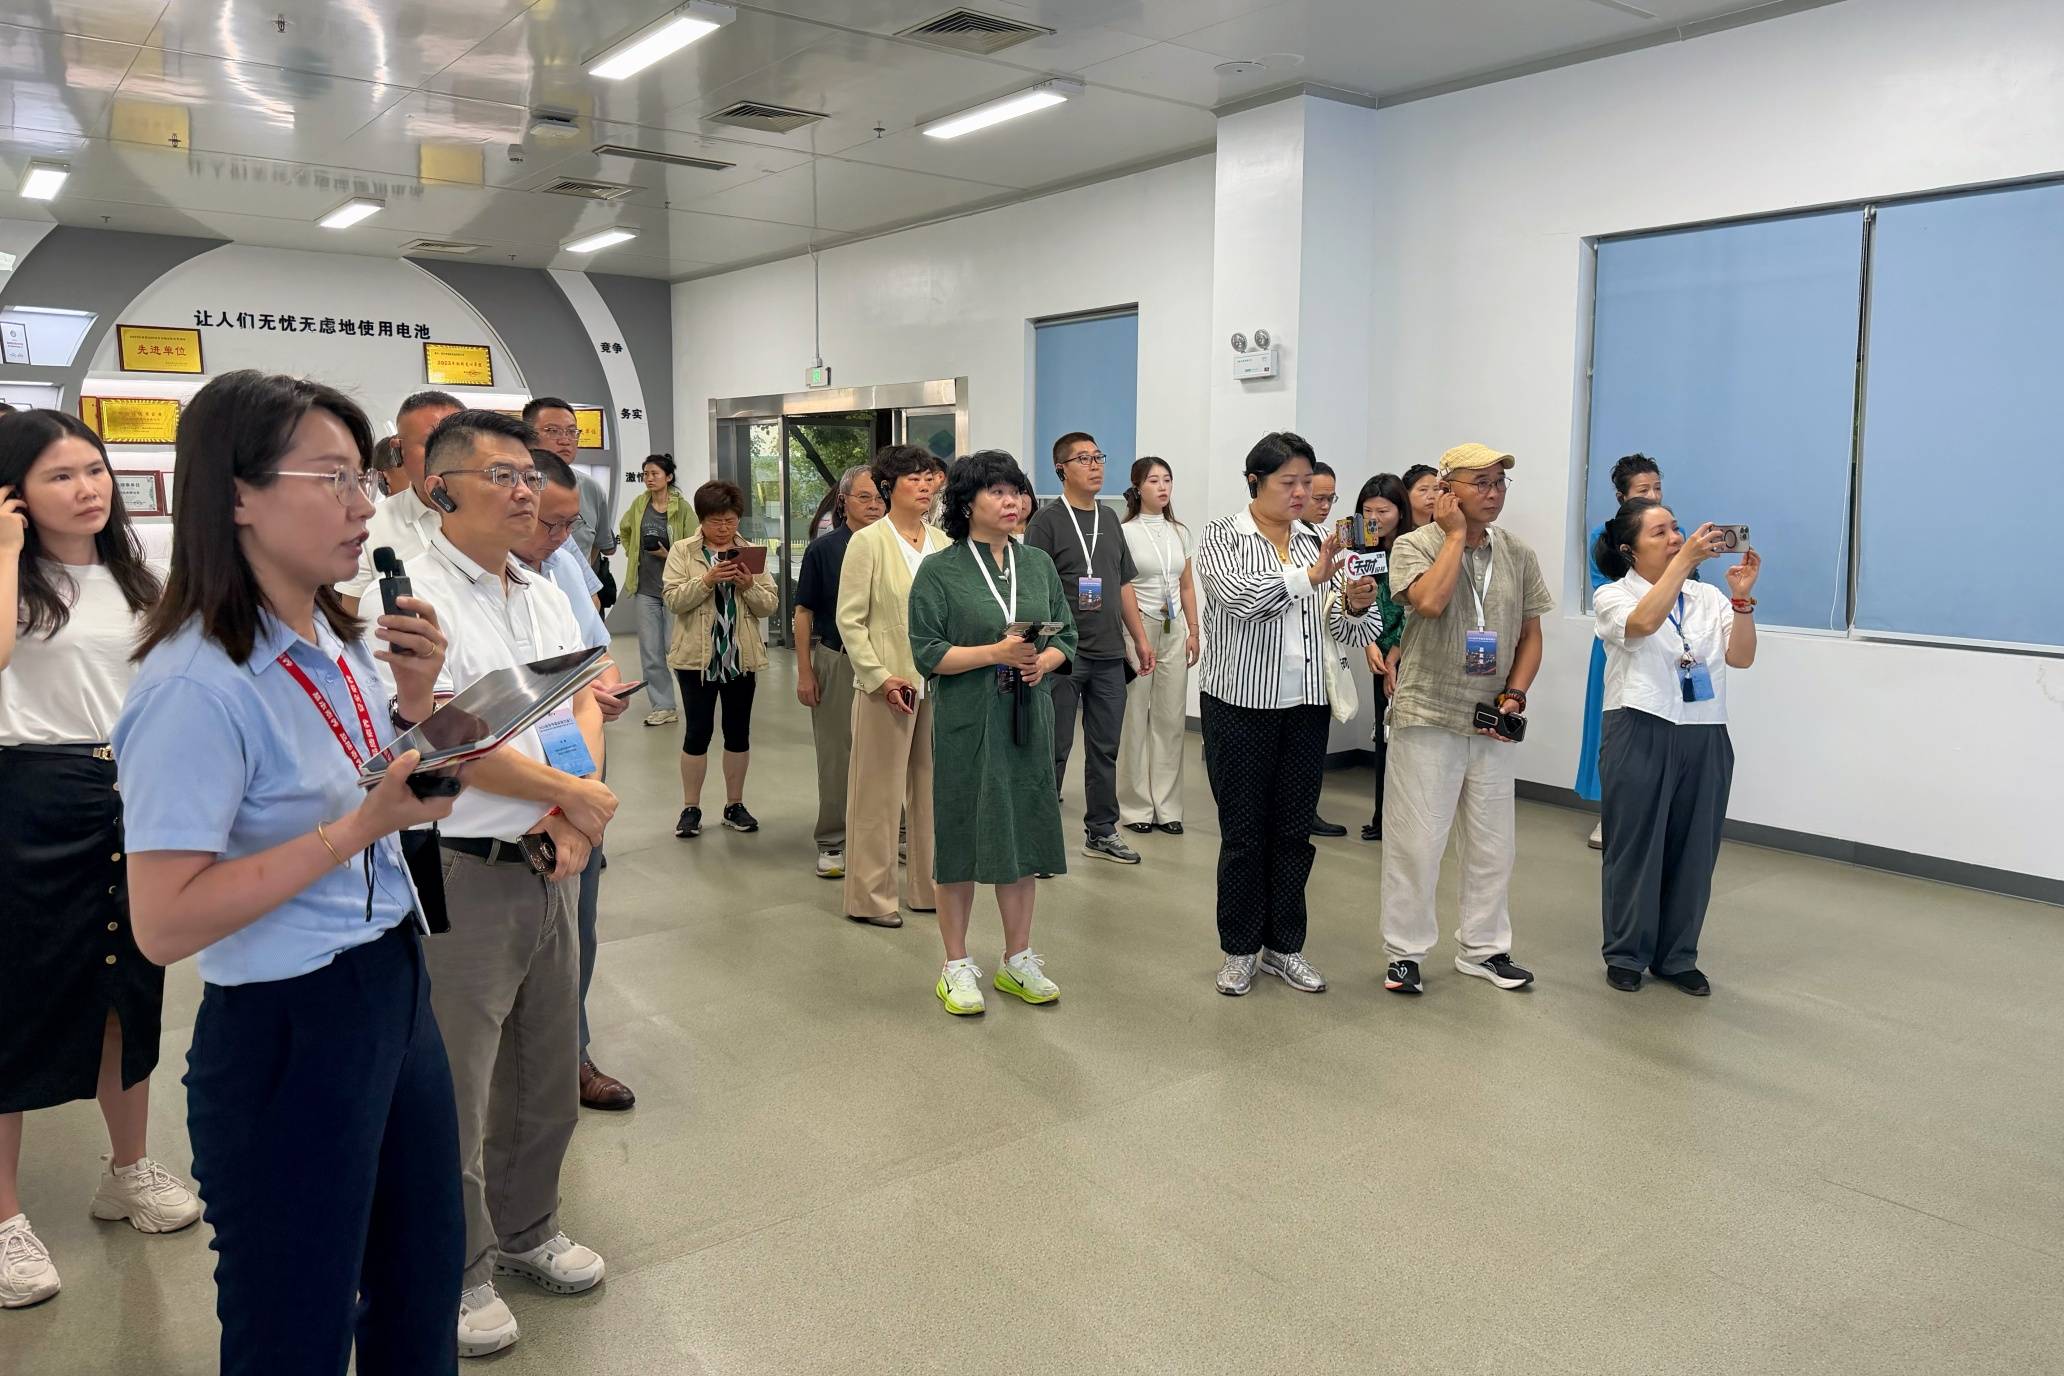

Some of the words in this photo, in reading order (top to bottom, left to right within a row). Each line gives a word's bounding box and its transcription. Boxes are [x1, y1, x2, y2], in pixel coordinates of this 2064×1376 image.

[194, 310, 431, 340] 让人们无忧无虑地使用电池
[137, 344, 187, 356] 先进单位
[600, 342, 623, 354] 竞争
[620, 408, 643, 420] 务实
